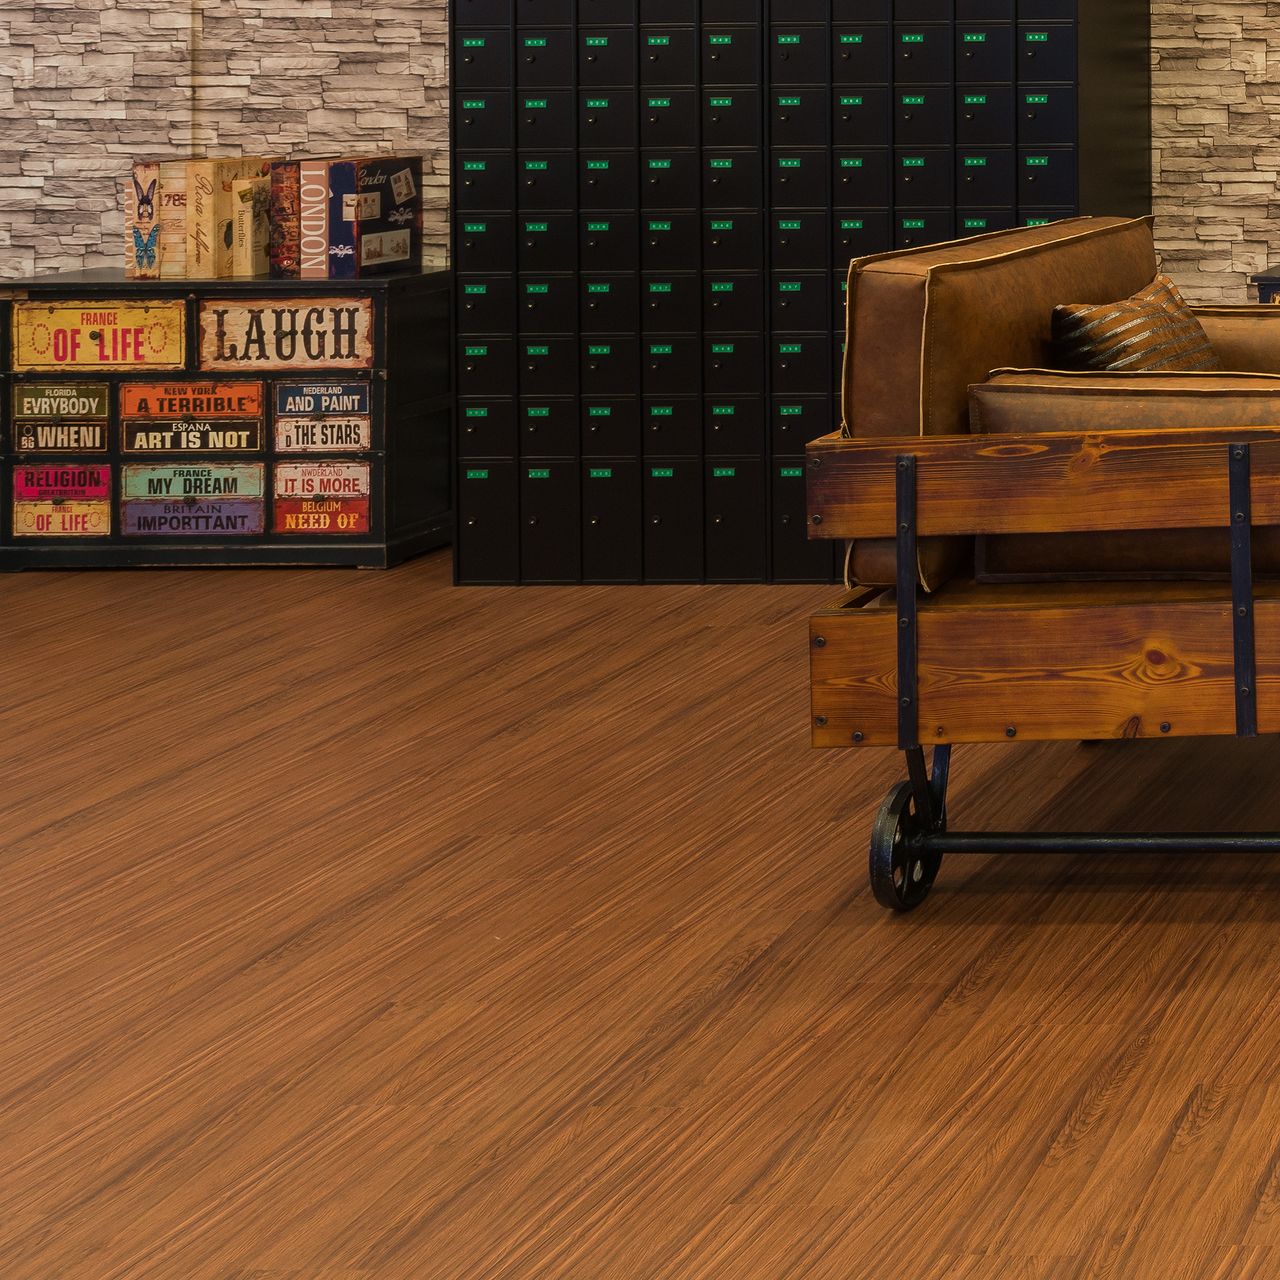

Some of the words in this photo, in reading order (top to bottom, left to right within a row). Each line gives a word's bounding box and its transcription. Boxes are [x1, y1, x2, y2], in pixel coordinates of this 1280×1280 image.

[194, 173, 214, 218] Rosa
[301, 169, 327, 270] LONDON
[212, 307, 360, 361] LAUGH
[53, 328, 81, 362] OF
[99, 327, 145, 362] LIFE
[45, 389, 77, 397] FLORIDA
[164, 387, 187, 395] NEW
[191, 386, 217, 395] YORK
[303, 387, 343, 395] NEDERLAND
[23, 397, 100, 414] EVRYBODY
[137, 398, 150, 412] A
[156, 397, 247, 412] TERRIBLE
[285, 397, 314, 412] AND
[321, 396, 361, 411] PAINT
[172, 423, 212, 431] ESPANA
[294, 424, 317, 445] THE
[320, 423, 361, 445] STARS
[37, 426, 101, 448] WHENI
[134, 432, 174, 449] ART
[180, 431, 201, 448] IS
[208, 431, 250, 448] NOT
[24, 470, 101, 488] RELIGION
[173, 469, 212, 477] FRANCE
[301, 468, 343, 477] NWDERLAND
[147, 478, 173, 494] MY
[183, 477, 238, 494] DREAM
[284, 478, 298, 493] IT
[301, 478, 315, 493] IS
[319, 478, 360, 493] MORE
[163, 504, 222, 513] BRITAIN
[302, 501, 341, 511] BELGIUM
[35, 514, 52, 531] OF
[61, 514, 88, 531] LIFE
[137, 515, 248, 531] IMPORTTANT
[284, 513, 331, 529] NEED
[336, 513, 359, 529] OF
